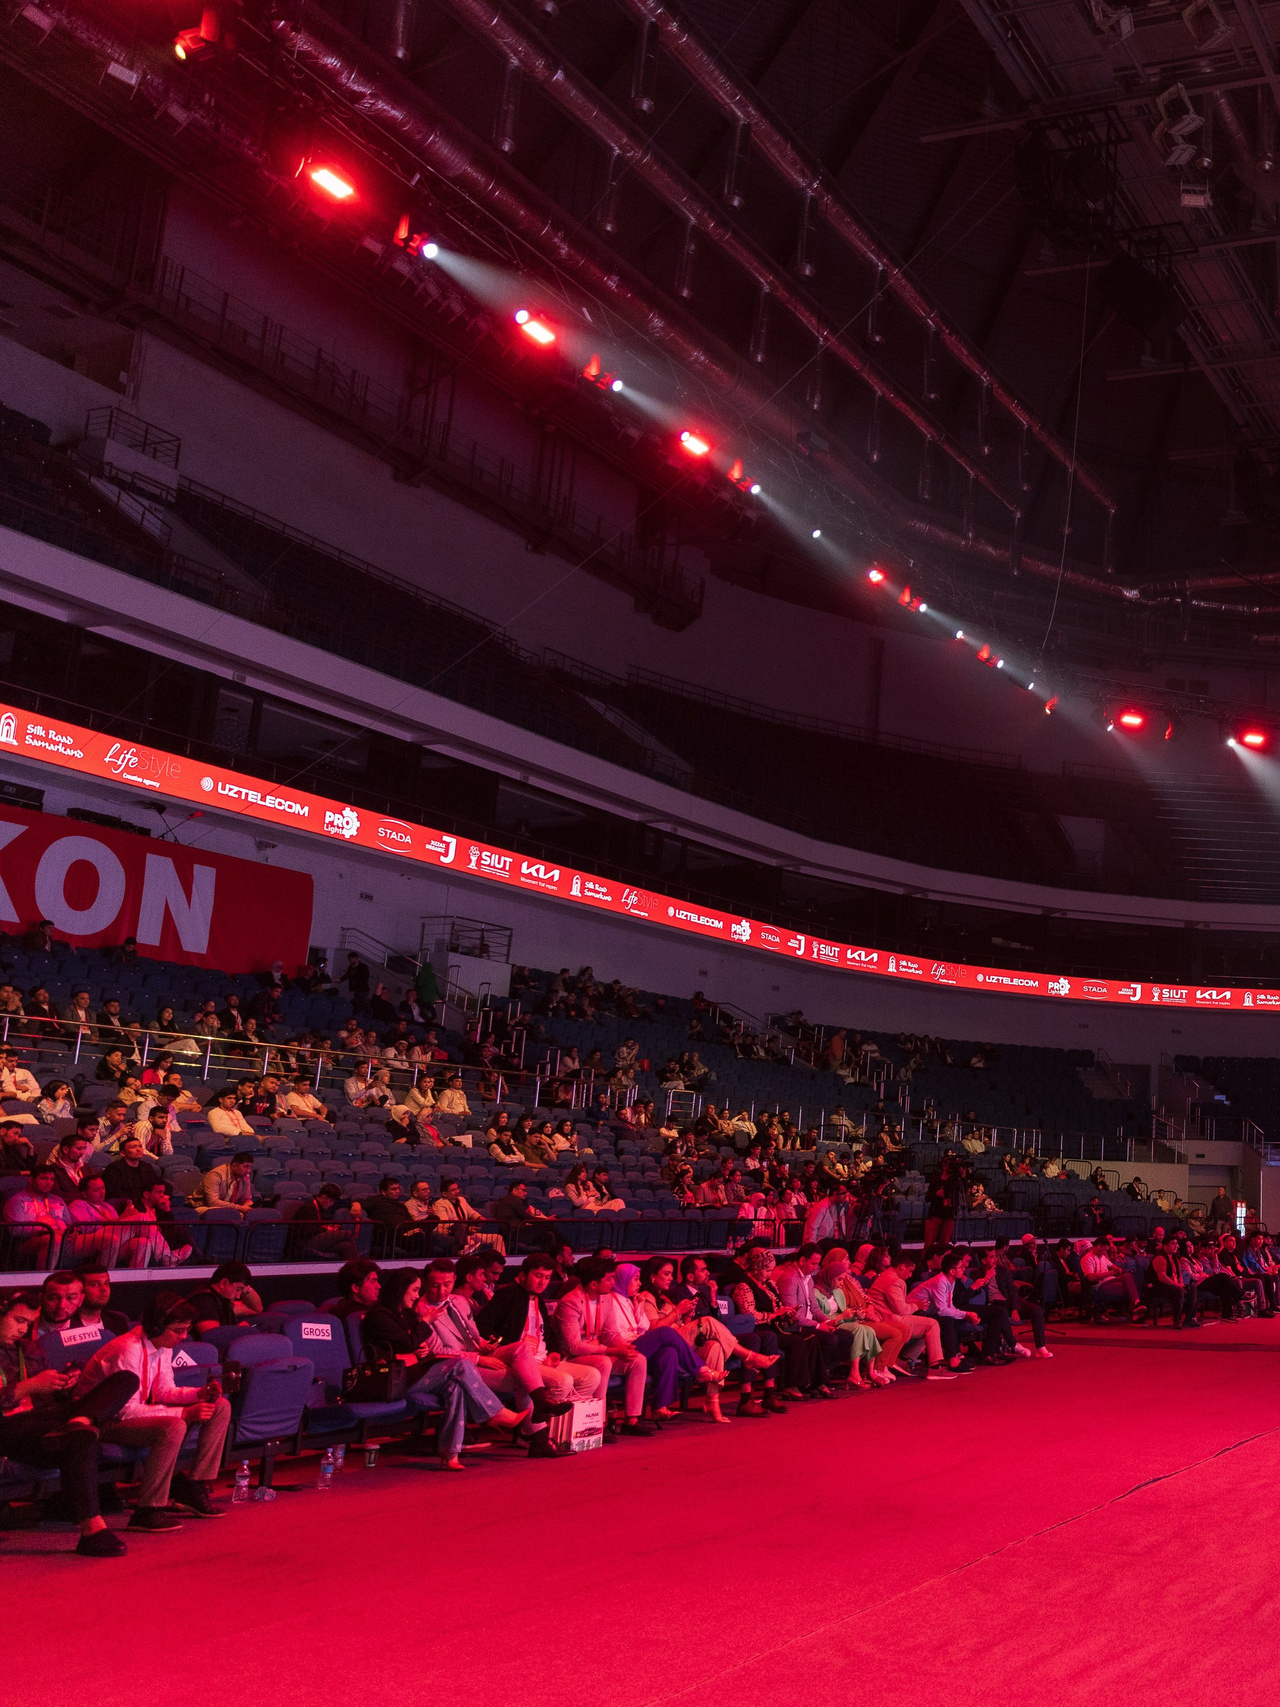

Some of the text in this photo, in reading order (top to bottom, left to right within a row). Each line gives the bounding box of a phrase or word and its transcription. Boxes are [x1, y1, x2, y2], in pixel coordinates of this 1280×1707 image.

[27, 723, 74, 746] Silk Road
[25, 734, 85, 760] Samarkand
[217, 781, 310, 818] UZTELECOM
[324, 810, 353, 829] PRO
[377, 827, 412, 845] STADA
[481, 851, 513, 871] SIUT
[521, 861, 560, 882] KIA
[675, 908, 723, 929] UZTELECOM
[731, 923, 748, 936] PRO
[760, 931, 780, 944] STADA
[820, 944, 840, 957] SIUT
[985, 975, 1039, 988] UZTELECOM
[1048, 981, 1066, 991] PRO
[1083, 985, 1108, 993] STADA
[1162, 989, 1188, 999] SIUT
[63, 1330, 99, 1343] LIFE STYLE
[303, 1327, 331, 1337] GROSS
